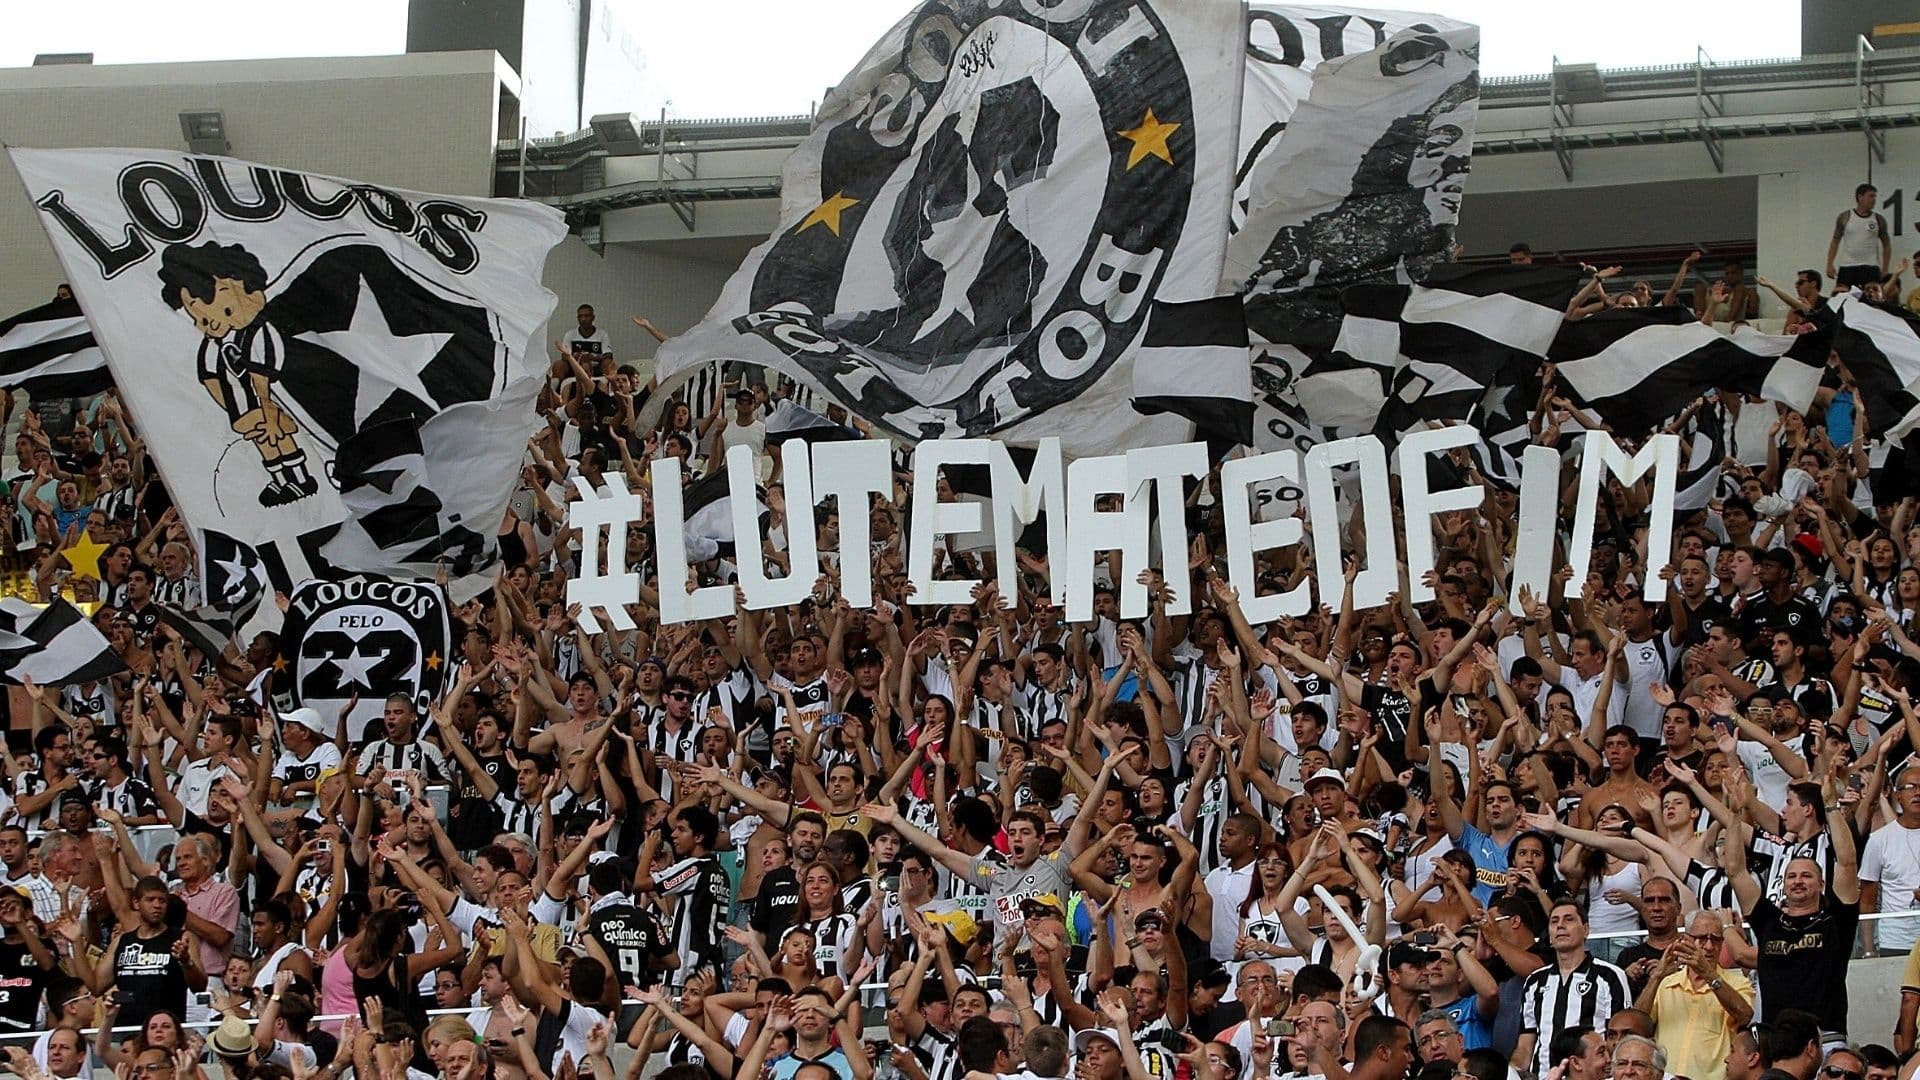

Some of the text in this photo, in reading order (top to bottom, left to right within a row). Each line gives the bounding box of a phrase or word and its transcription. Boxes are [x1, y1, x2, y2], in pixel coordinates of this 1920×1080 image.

[37, 155, 487, 280] LOUCOS
[1883, 188, 1920, 237] 1
[293, 574, 434, 620] LOUCOS
[339, 615, 384, 628] PELO
[302, 629, 418, 699] 22
[663, 865, 698, 890] bozzano
[600, 919, 625, 932] neo
[618, 948, 641, 987] 9
